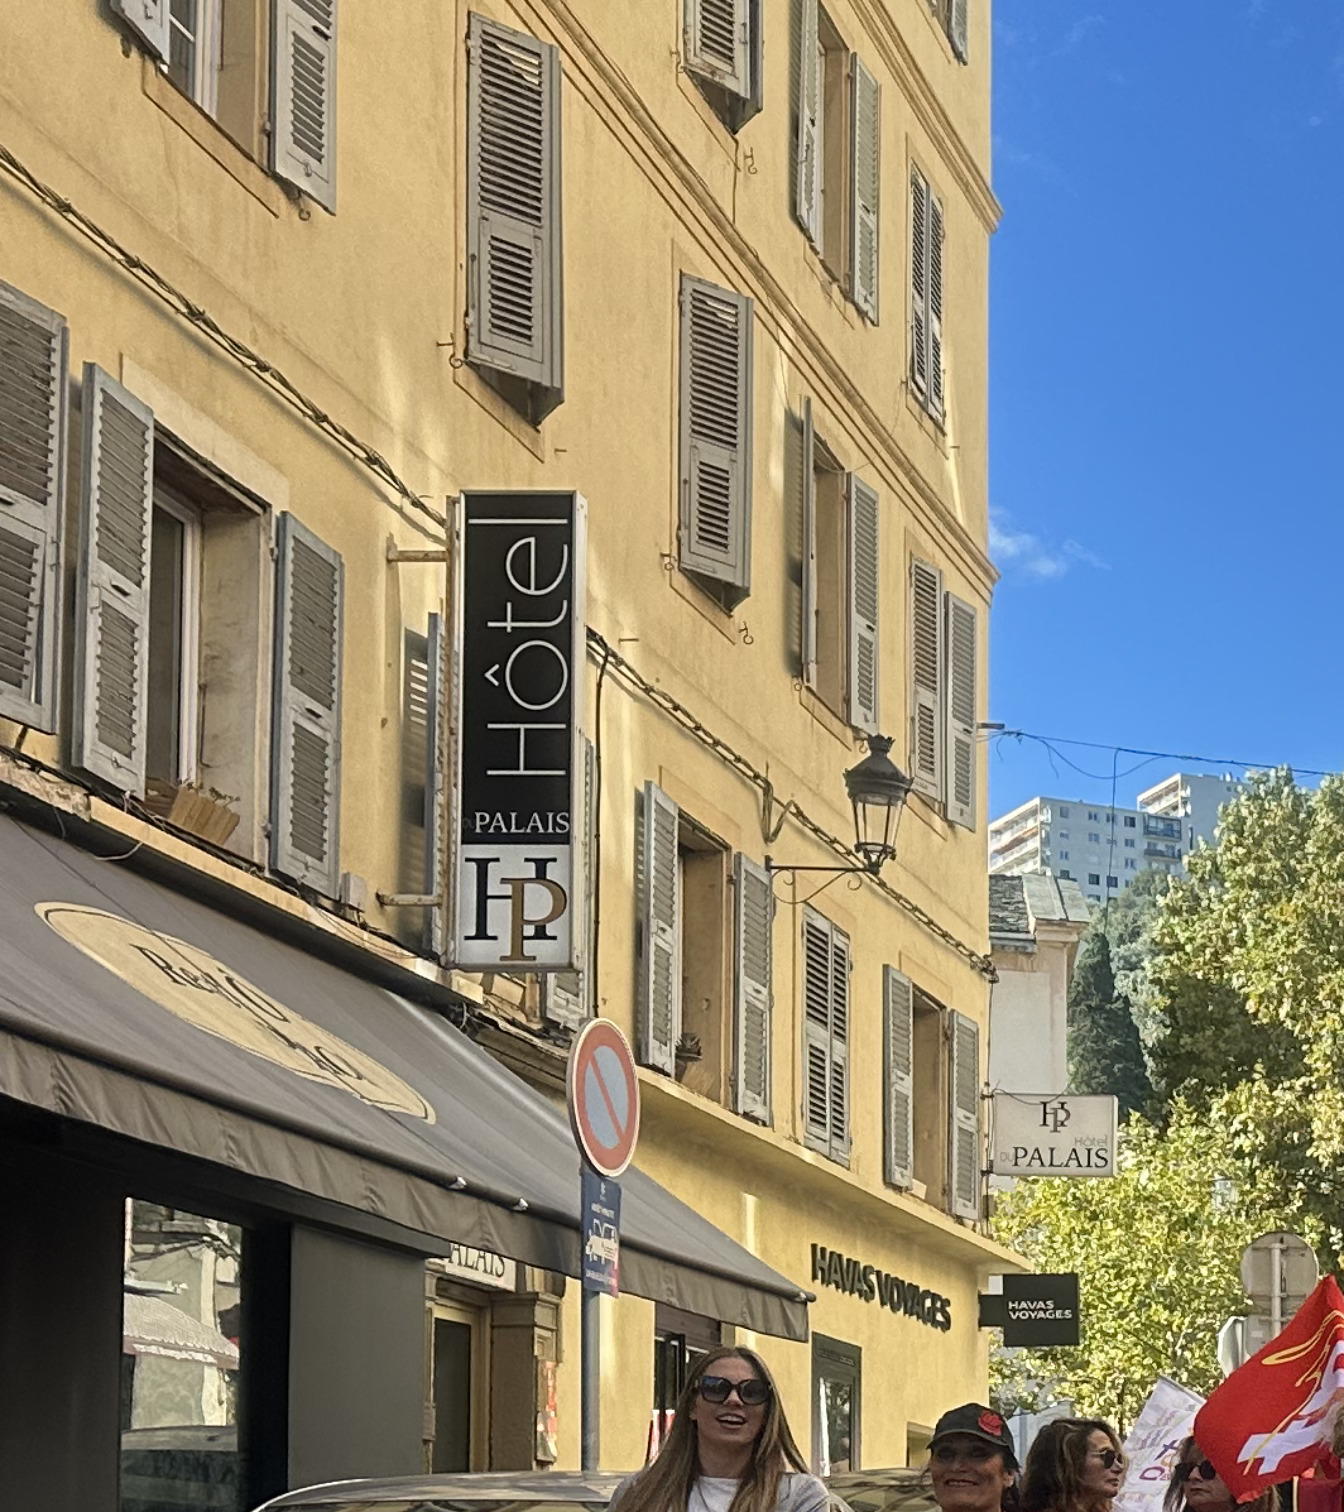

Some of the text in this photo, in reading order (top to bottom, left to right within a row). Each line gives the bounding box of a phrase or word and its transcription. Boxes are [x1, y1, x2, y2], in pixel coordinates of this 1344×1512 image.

[468, 518, 569, 777] Hôtel
[474, 811, 570, 834] PALAIS
[1012, 1146, 1109, 1168] PALAIS
[810, 1243, 951, 1333] HAVAS VOYAGES
[1008, 1300, 1054, 1310] HAVAS
[1008, 1309, 1073, 1320] VOYAGES
